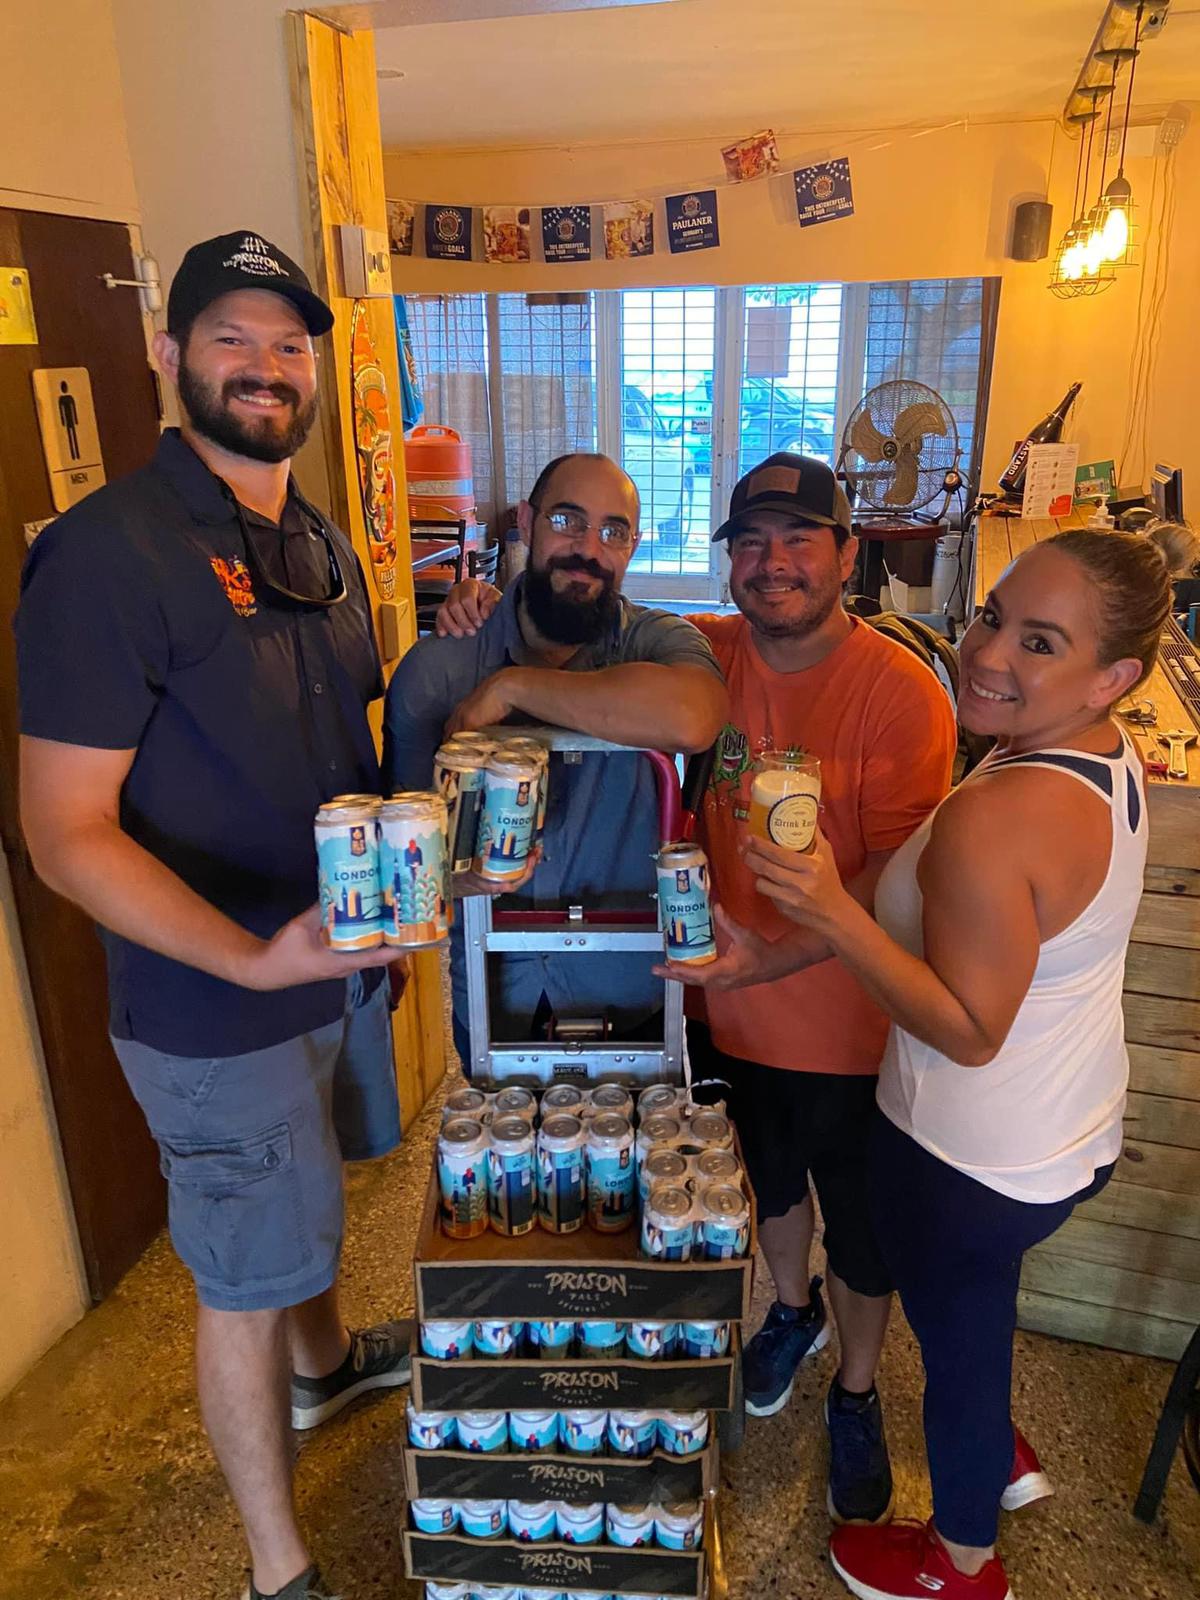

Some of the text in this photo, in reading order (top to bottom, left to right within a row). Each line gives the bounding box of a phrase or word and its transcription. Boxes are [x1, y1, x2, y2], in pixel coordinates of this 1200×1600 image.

[672, 215, 712, 230] PAULANER
[231, 252, 281, 275] PRISON
[1008, 440, 1033, 476] BASTARD
[70, 471, 89, 485] MEN
[497, 815, 534, 826] LONDO
[774, 817, 799, 828] Drink
[334, 868, 380, 881] LONDO
[665, 901, 706, 913] LONDON
[545, 1272, 627, 1297] PRISON
[539, 1371, 619, 1391] PRISON
[528, 1464, 604, 1488] PRISON
[518, 1552, 592, 1574] PRISON
